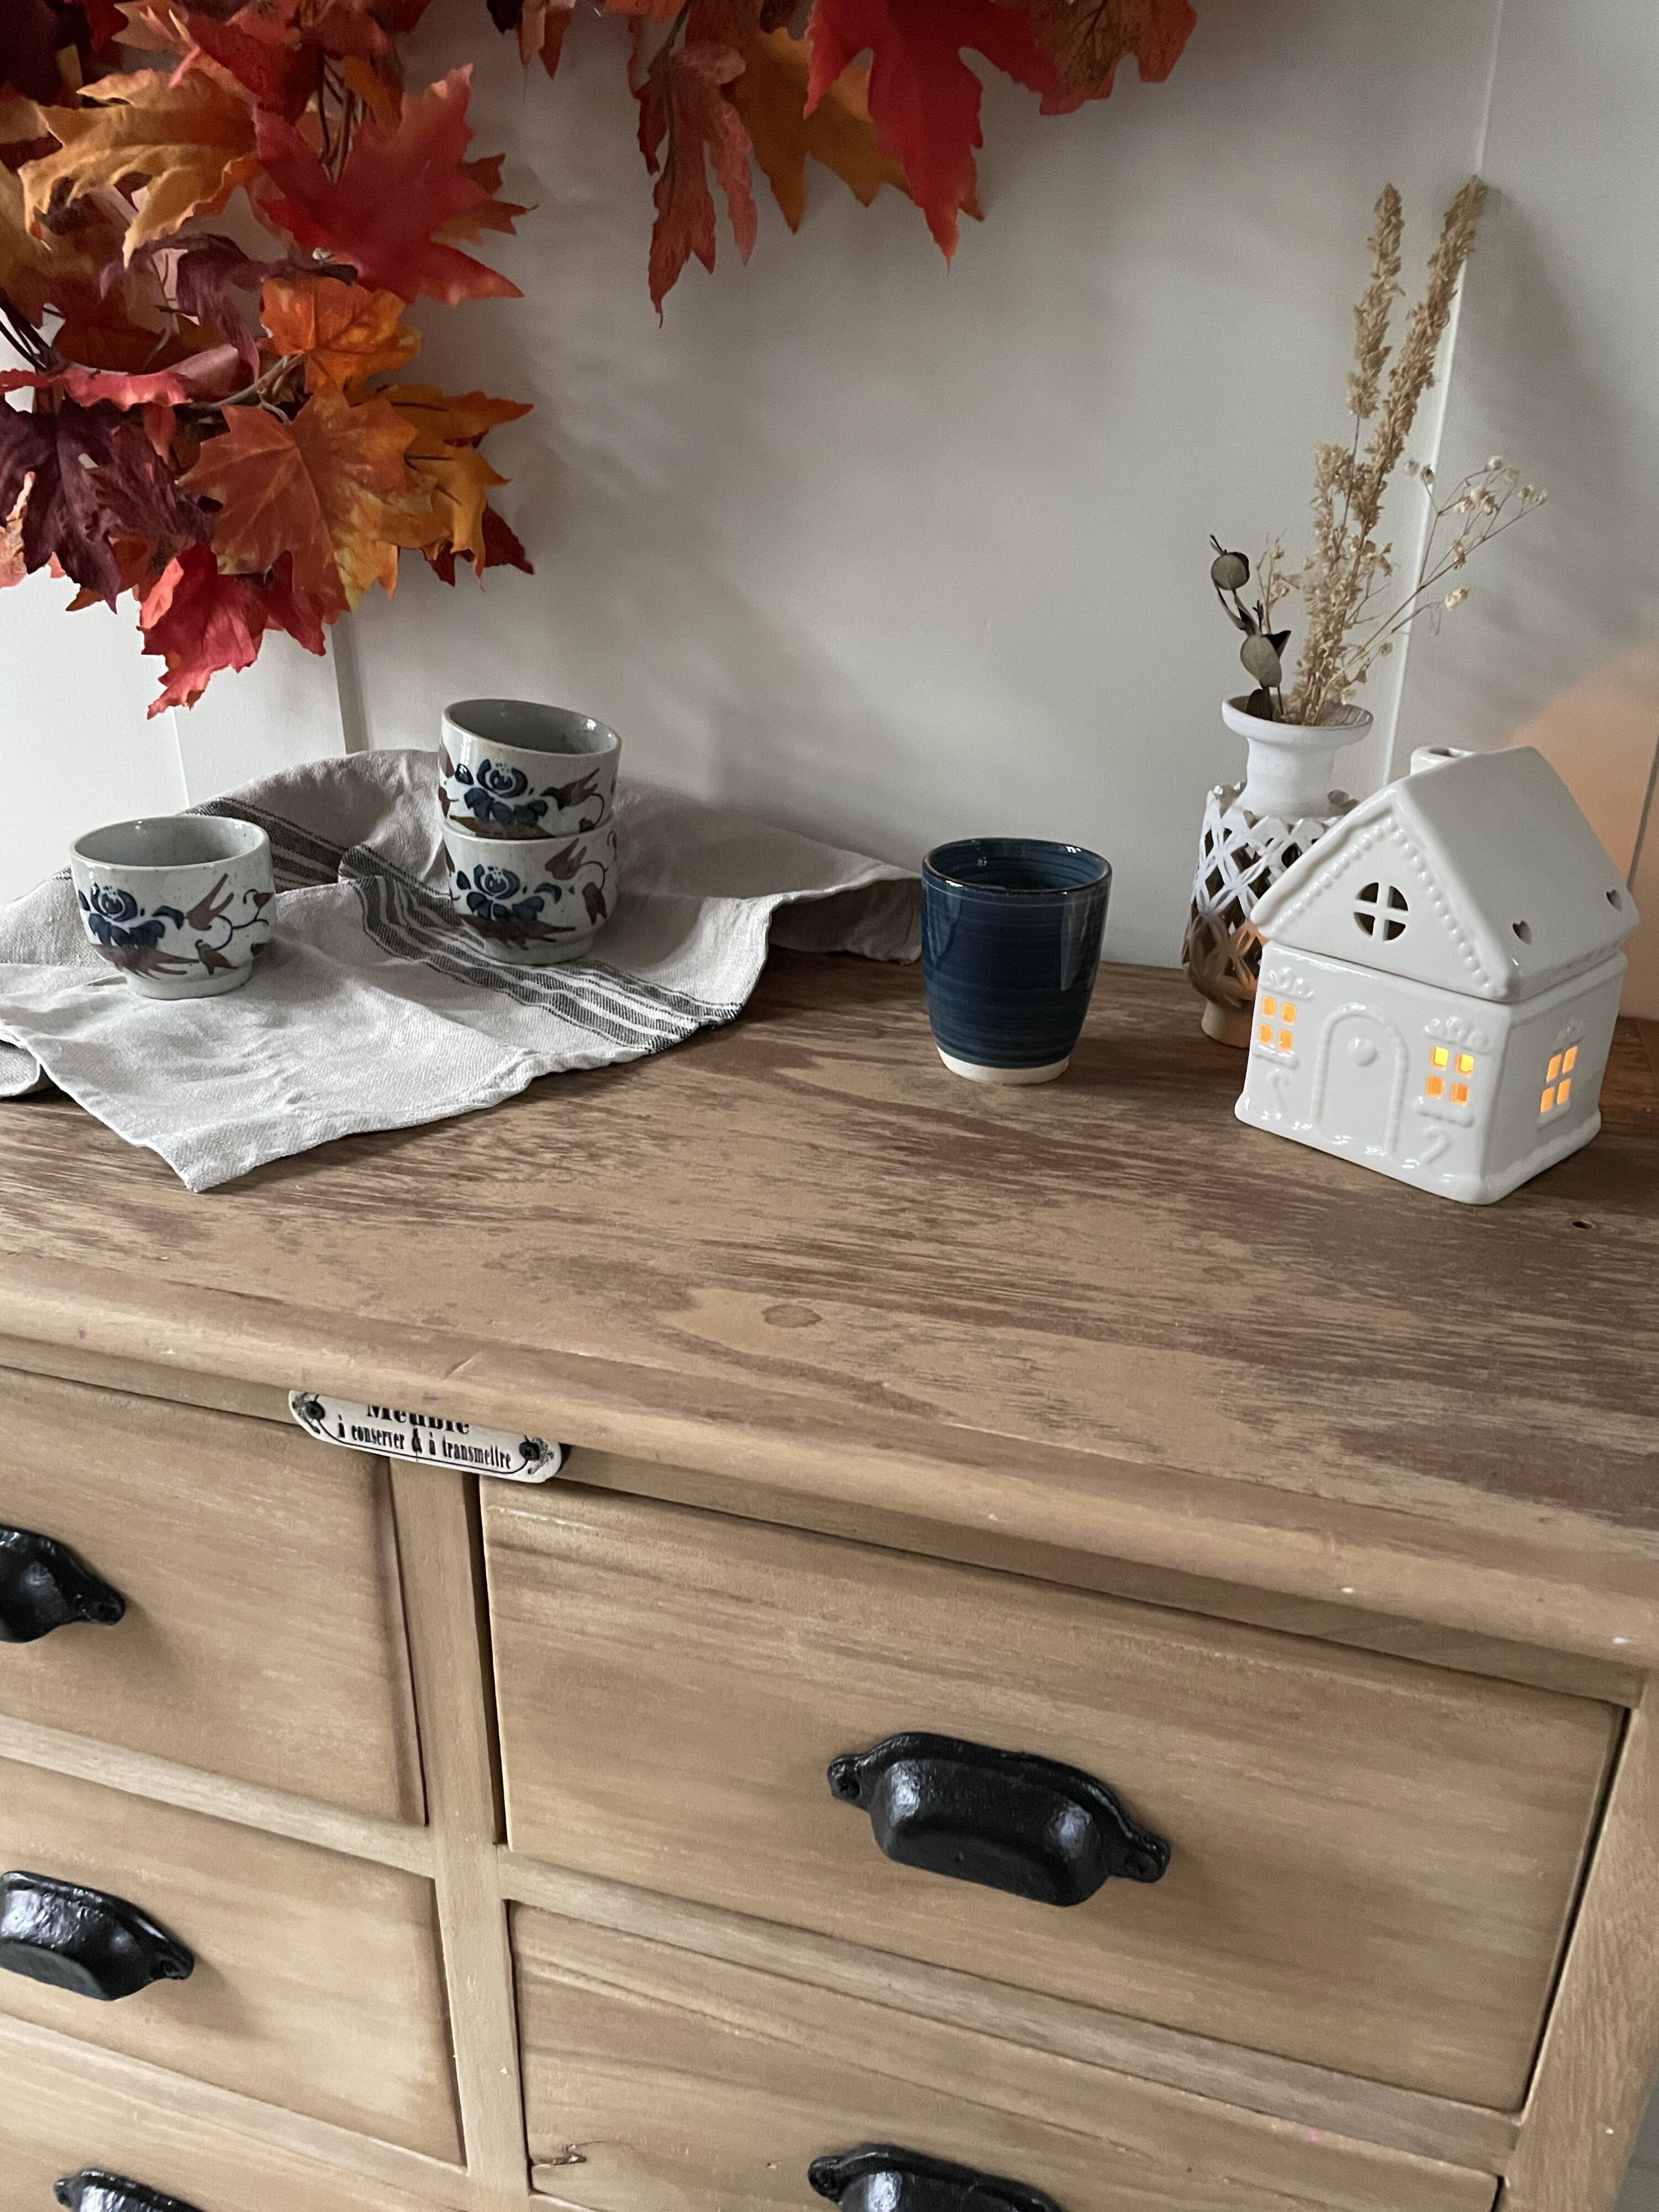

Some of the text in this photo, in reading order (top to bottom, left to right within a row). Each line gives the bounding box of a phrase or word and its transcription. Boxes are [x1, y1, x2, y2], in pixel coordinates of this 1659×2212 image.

[351, 1425, 405, 1450] conserver
[411, 1427, 422, 1454] &
[429, 1432, 436, 1455] à
[442, 1435, 512, 1469] transmettre
